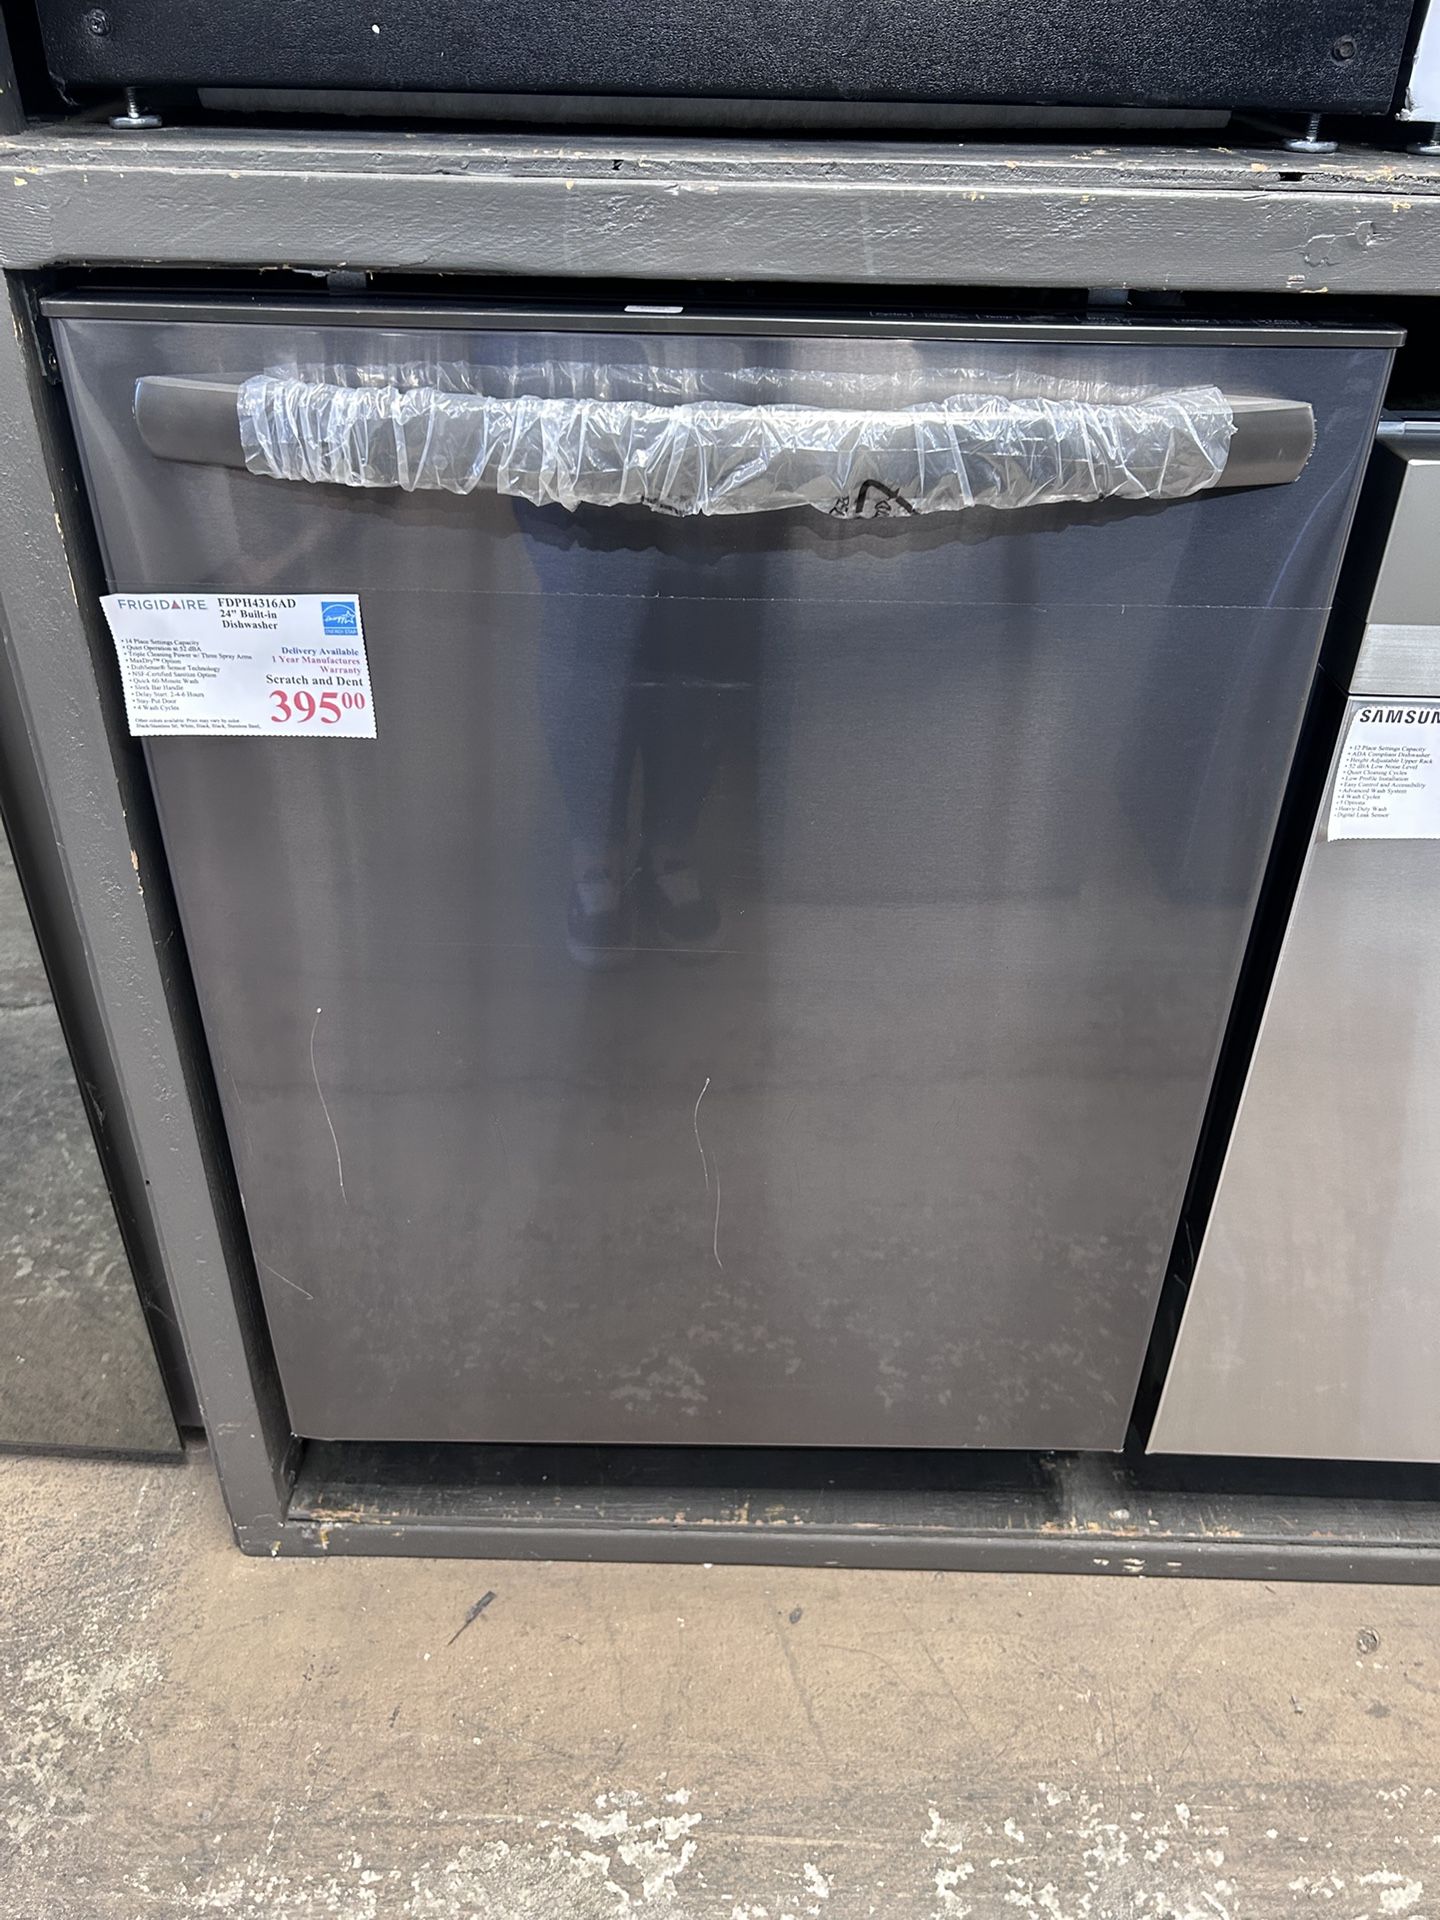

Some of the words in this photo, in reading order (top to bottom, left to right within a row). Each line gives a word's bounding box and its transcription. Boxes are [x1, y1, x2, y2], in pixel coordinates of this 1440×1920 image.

[117, 599, 208, 610] FRIGIDAIRE
[217, 598, 297, 609] FDPH4316AD
[220, 609, 237, 618] 24"
[240, 610, 277, 619] Built-in
[222, 620, 279, 630] Dishwasher
[150, 639, 173, 647] Settings
[144, 645, 172, 653] Operation
[281, 647, 317, 656] Delivery
[319, 648, 359, 656] Available
[302, 656, 361, 665] Manufactures
[320, 666, 361, 675] Warranty
[266, 674, 309, 685] Scratch
[312, 676, 333, 686] and
[337, 676, 363, 687] Dent
